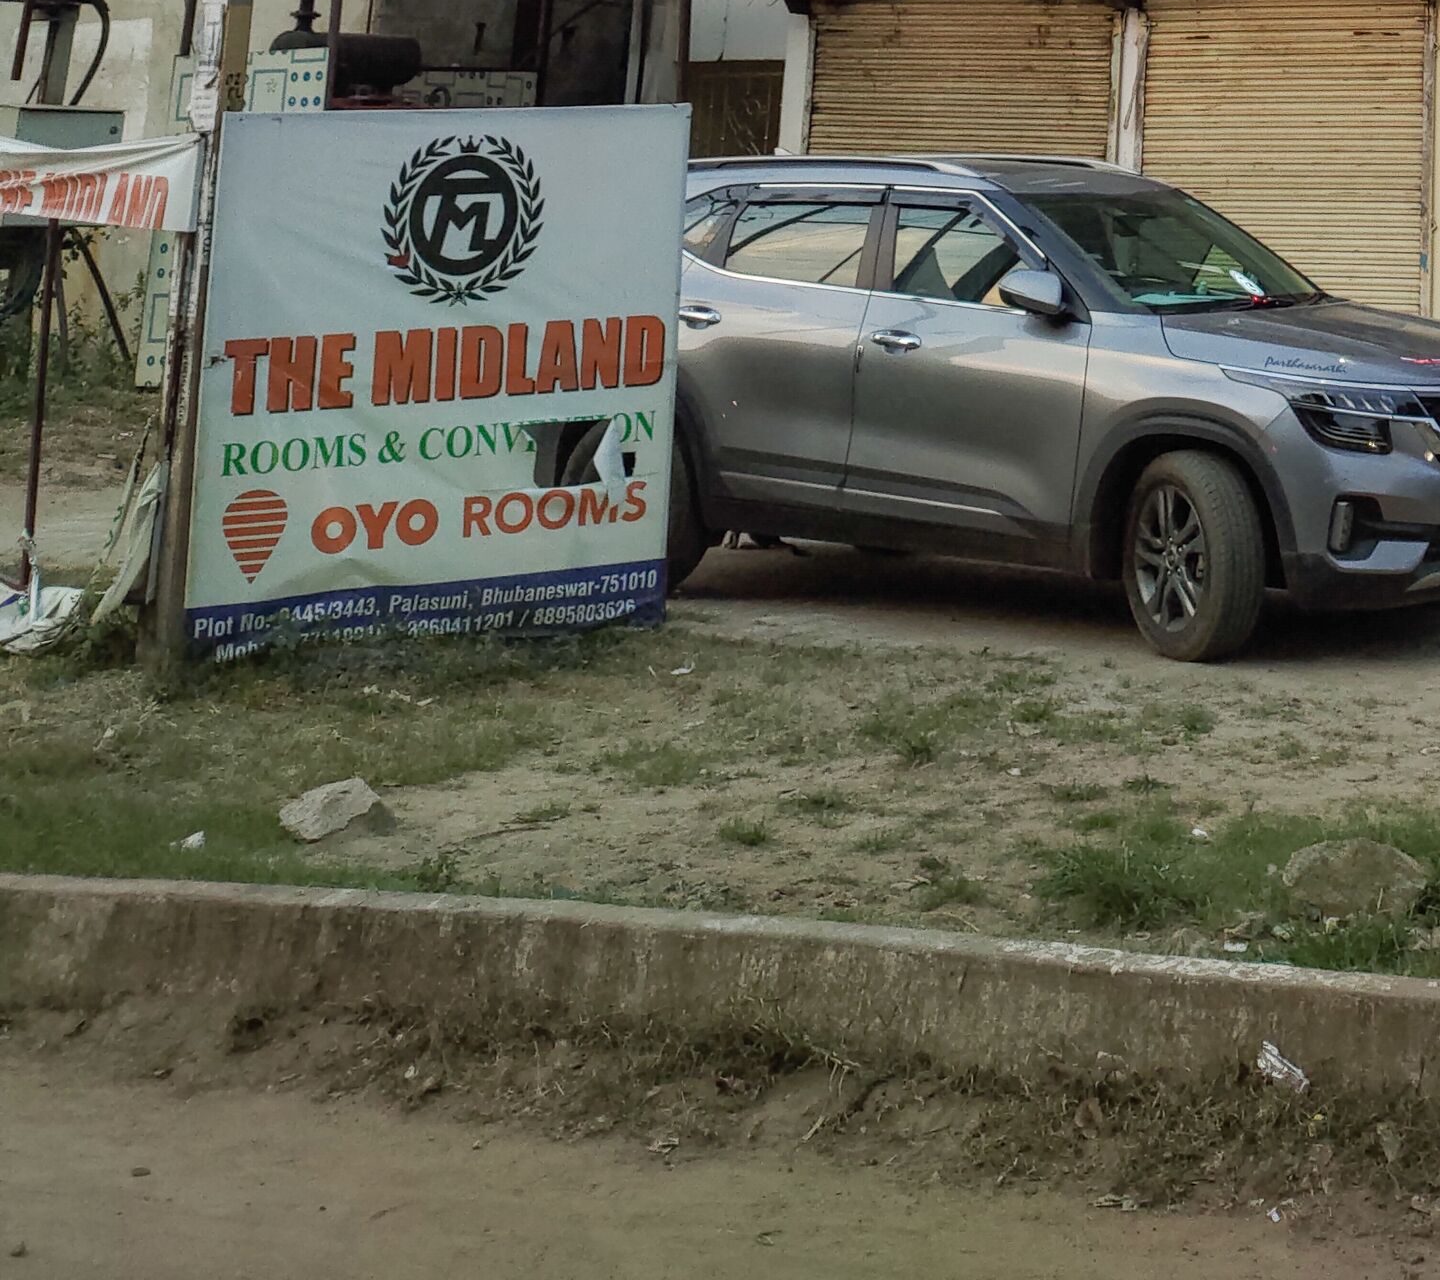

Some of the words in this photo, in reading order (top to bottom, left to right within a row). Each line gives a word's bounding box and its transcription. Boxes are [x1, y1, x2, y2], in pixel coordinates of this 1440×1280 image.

[41, 171, 170, 231] MIDLAND
[224, 333, 357, 416] THE
[371, 314, 666, 407] MIDLAND
[220, 433, 366, 478] ROOMS
[378, 431, 406, 463] &
[310, 498, 439, 555] OYO
[463, 480, 648, 539] ROOMS
[193, 616, 234, 639] Plot
[389, 590, 473, 614] Palasuni,
[481, 571, 657, 607] Bhubaneswar-751010
[533, 599, 637, 626] 8895803626
